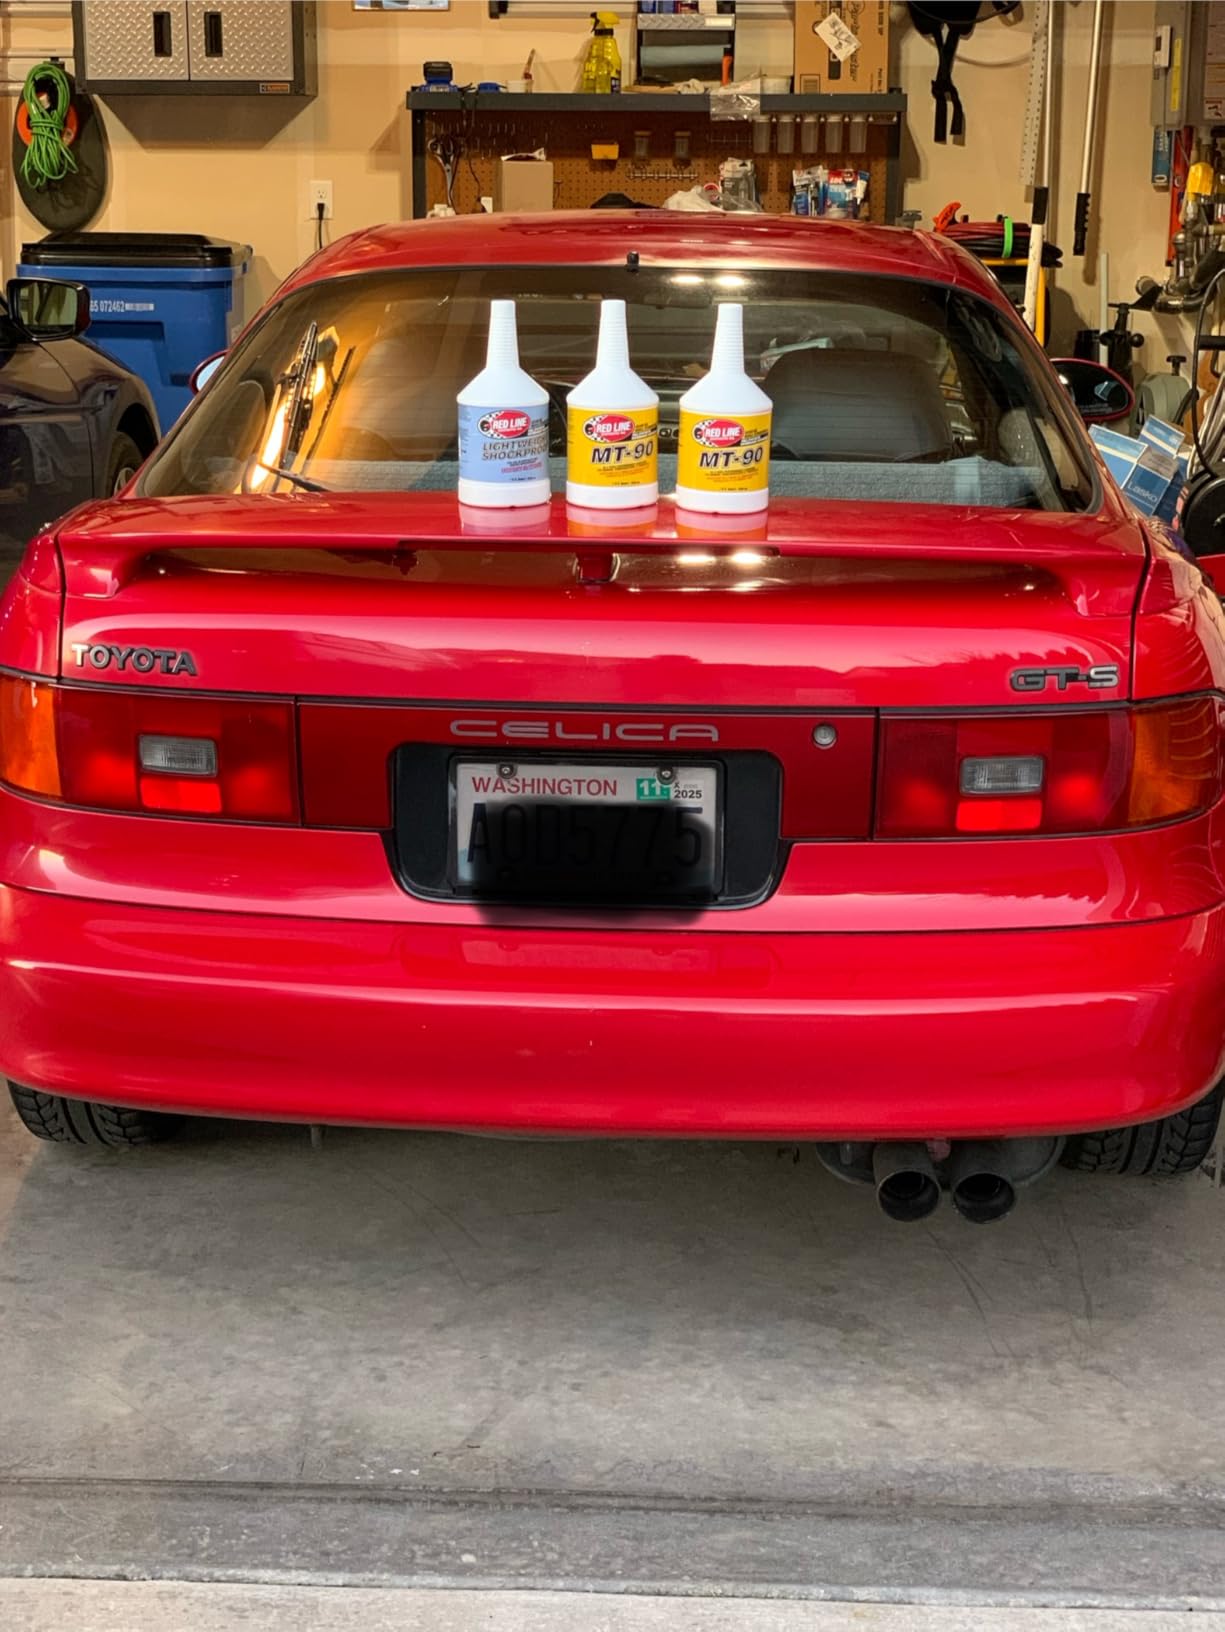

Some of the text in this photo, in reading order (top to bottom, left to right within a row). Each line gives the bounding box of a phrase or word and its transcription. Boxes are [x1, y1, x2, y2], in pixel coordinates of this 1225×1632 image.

[492, 420, 509, 429] RED
[510, 417, 527, 428] LINE
[597, 423, 612, 433] RED
[613, 420, 632, 431] LINE
[705, 427, 721, 437] RED
[722, 426, 741, 437] LINE
[481, 446, 547, 461] SHOCKPRO
[482, 435, 548, 451] LIGHTWEIG
[591, 440, 654, 463] MT-90
[699, 446, 763, 467] MT-90
[1127, 481, 1159, 503] Lasko
[71, 643, 197, 676] TOYOTA
[1010, 666, 1119, 692] GT-S
[450, 719, 719, 742] CELICA
[472, 776, 617, 797] WASHINGTON
[674, 790, 703, 799] 2025
